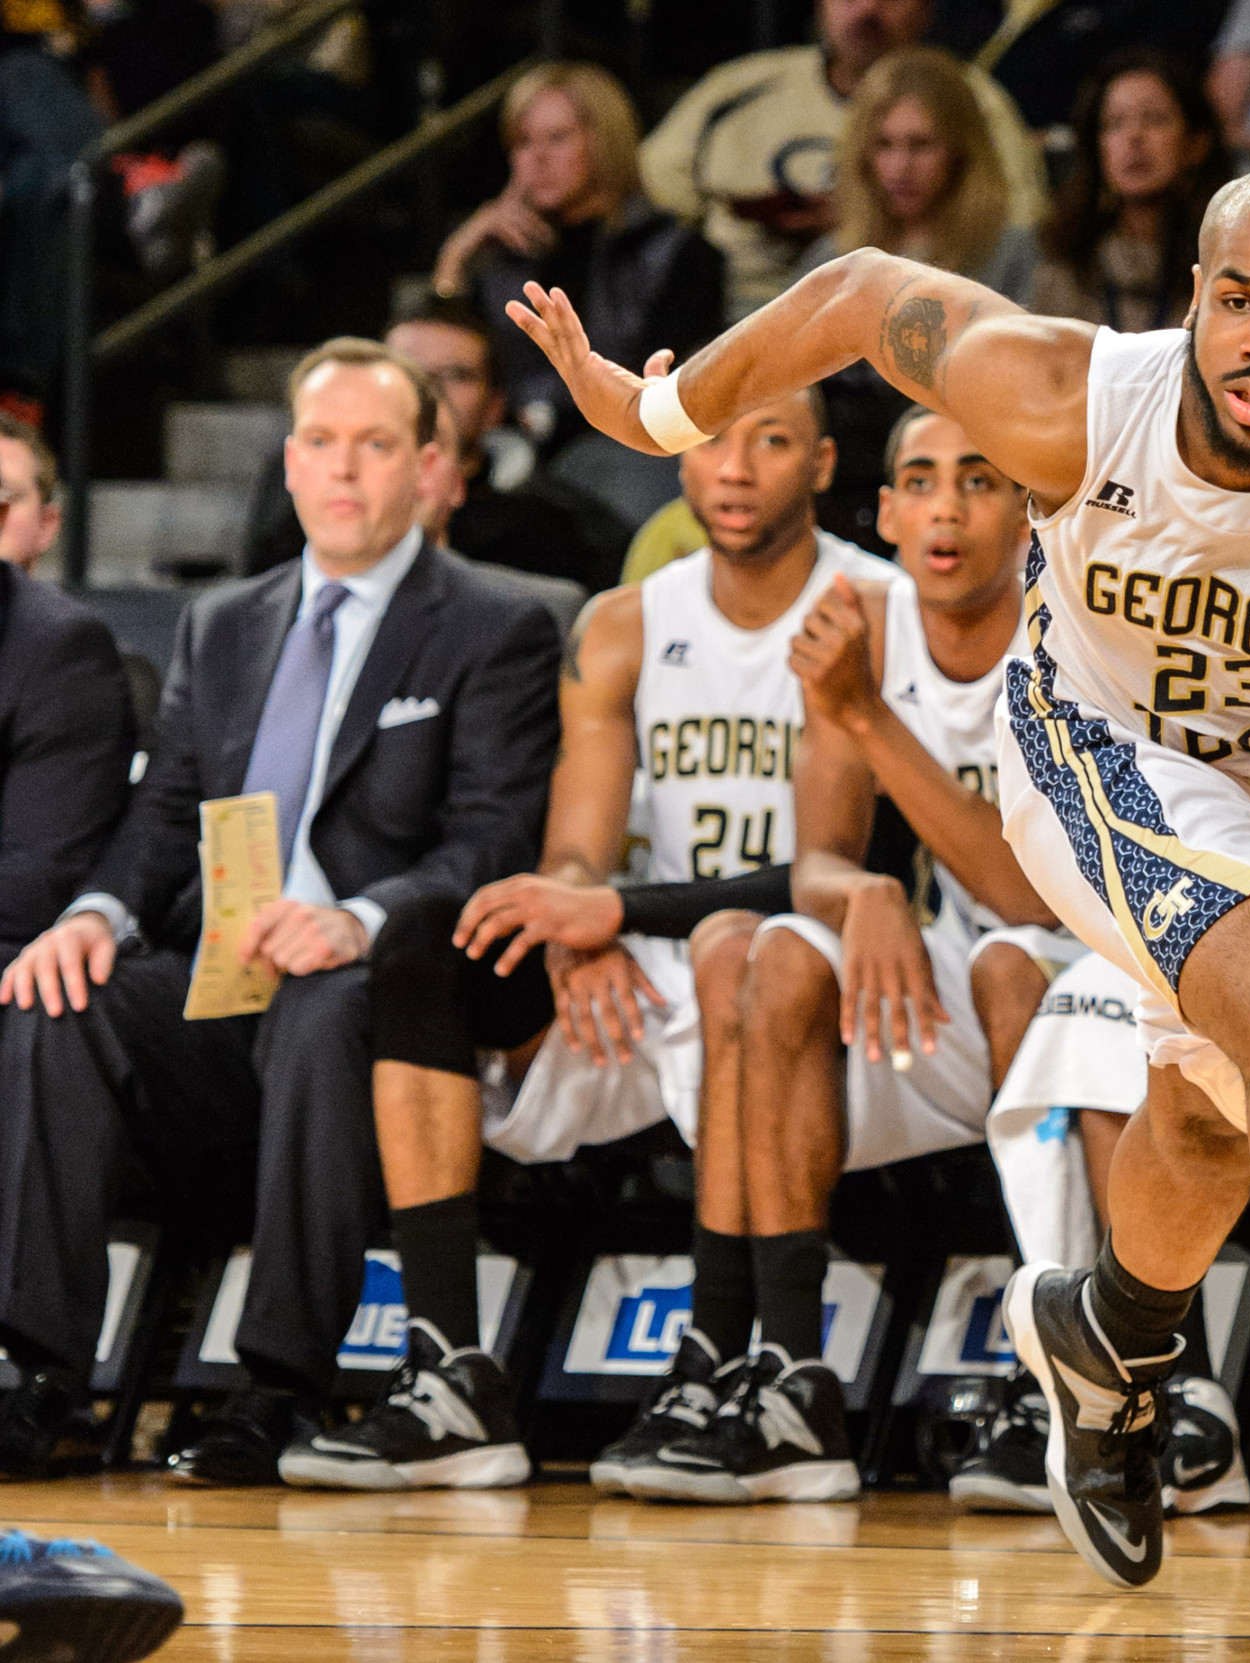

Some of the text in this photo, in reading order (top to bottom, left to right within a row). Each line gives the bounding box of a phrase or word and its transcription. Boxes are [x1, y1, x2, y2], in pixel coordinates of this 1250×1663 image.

[1085, 499, 1137, 519] RUSSELL
[649, 717, 799, 781] GEORGI
[692, 805, 774, 879] 24
